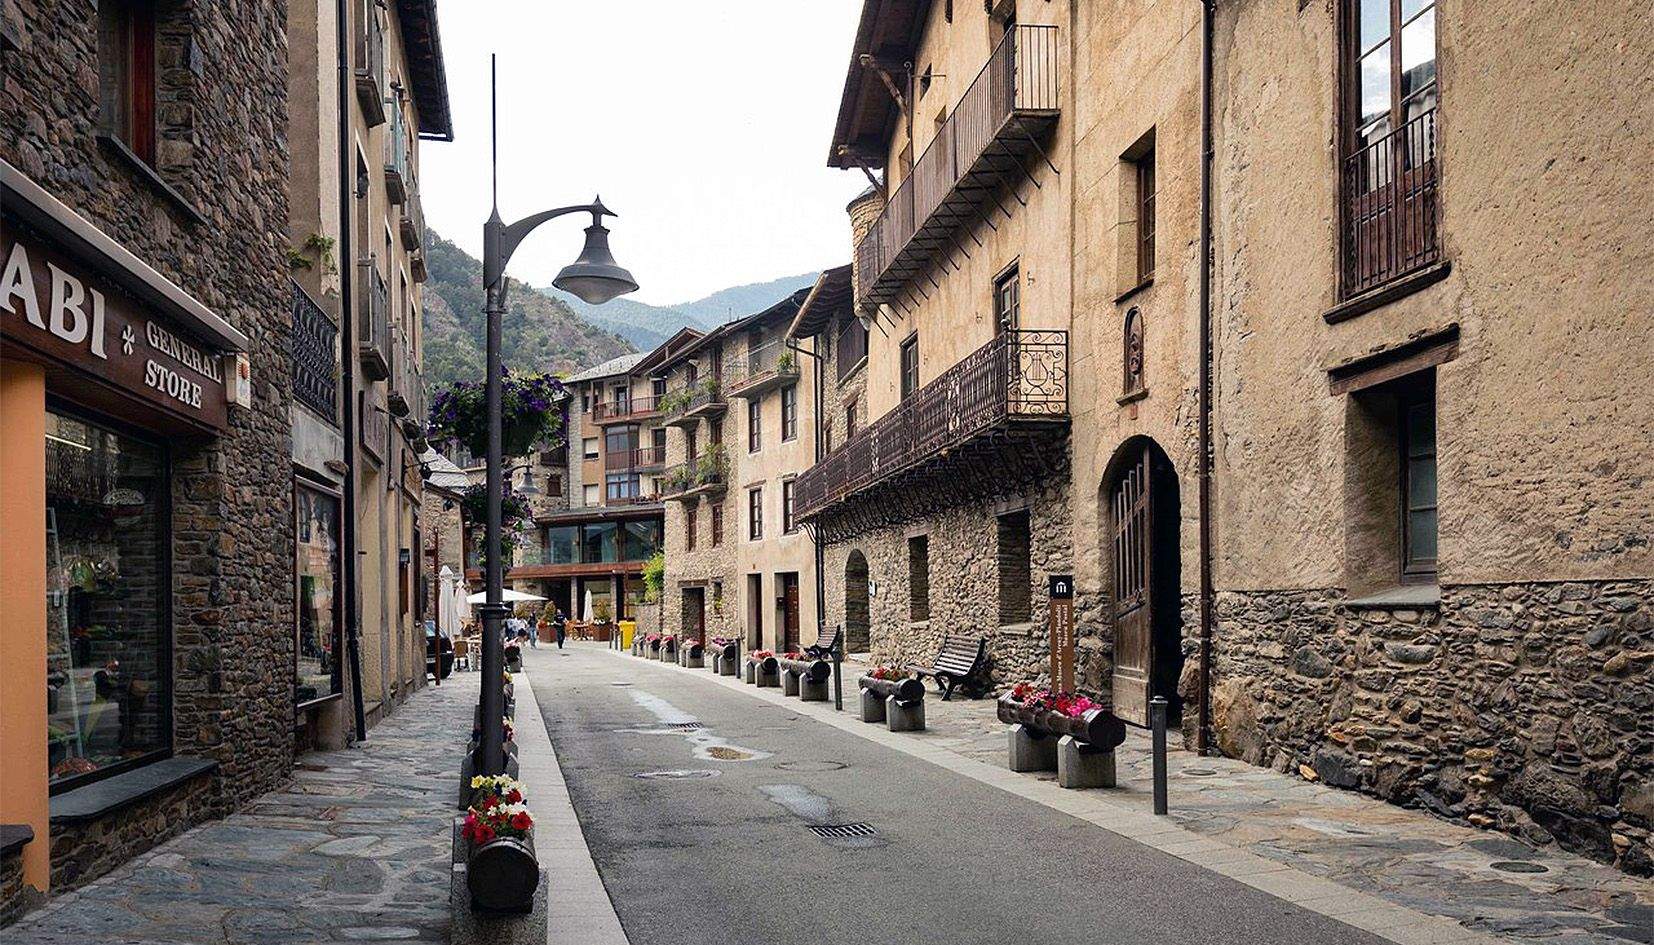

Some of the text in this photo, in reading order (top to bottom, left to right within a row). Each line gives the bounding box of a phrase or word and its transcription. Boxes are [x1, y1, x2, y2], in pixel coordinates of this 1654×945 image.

[0, 242, 108, 360] ABI
[145, 359, 202, 409] STORE
[146, 320, 222, 384] GENERAL
